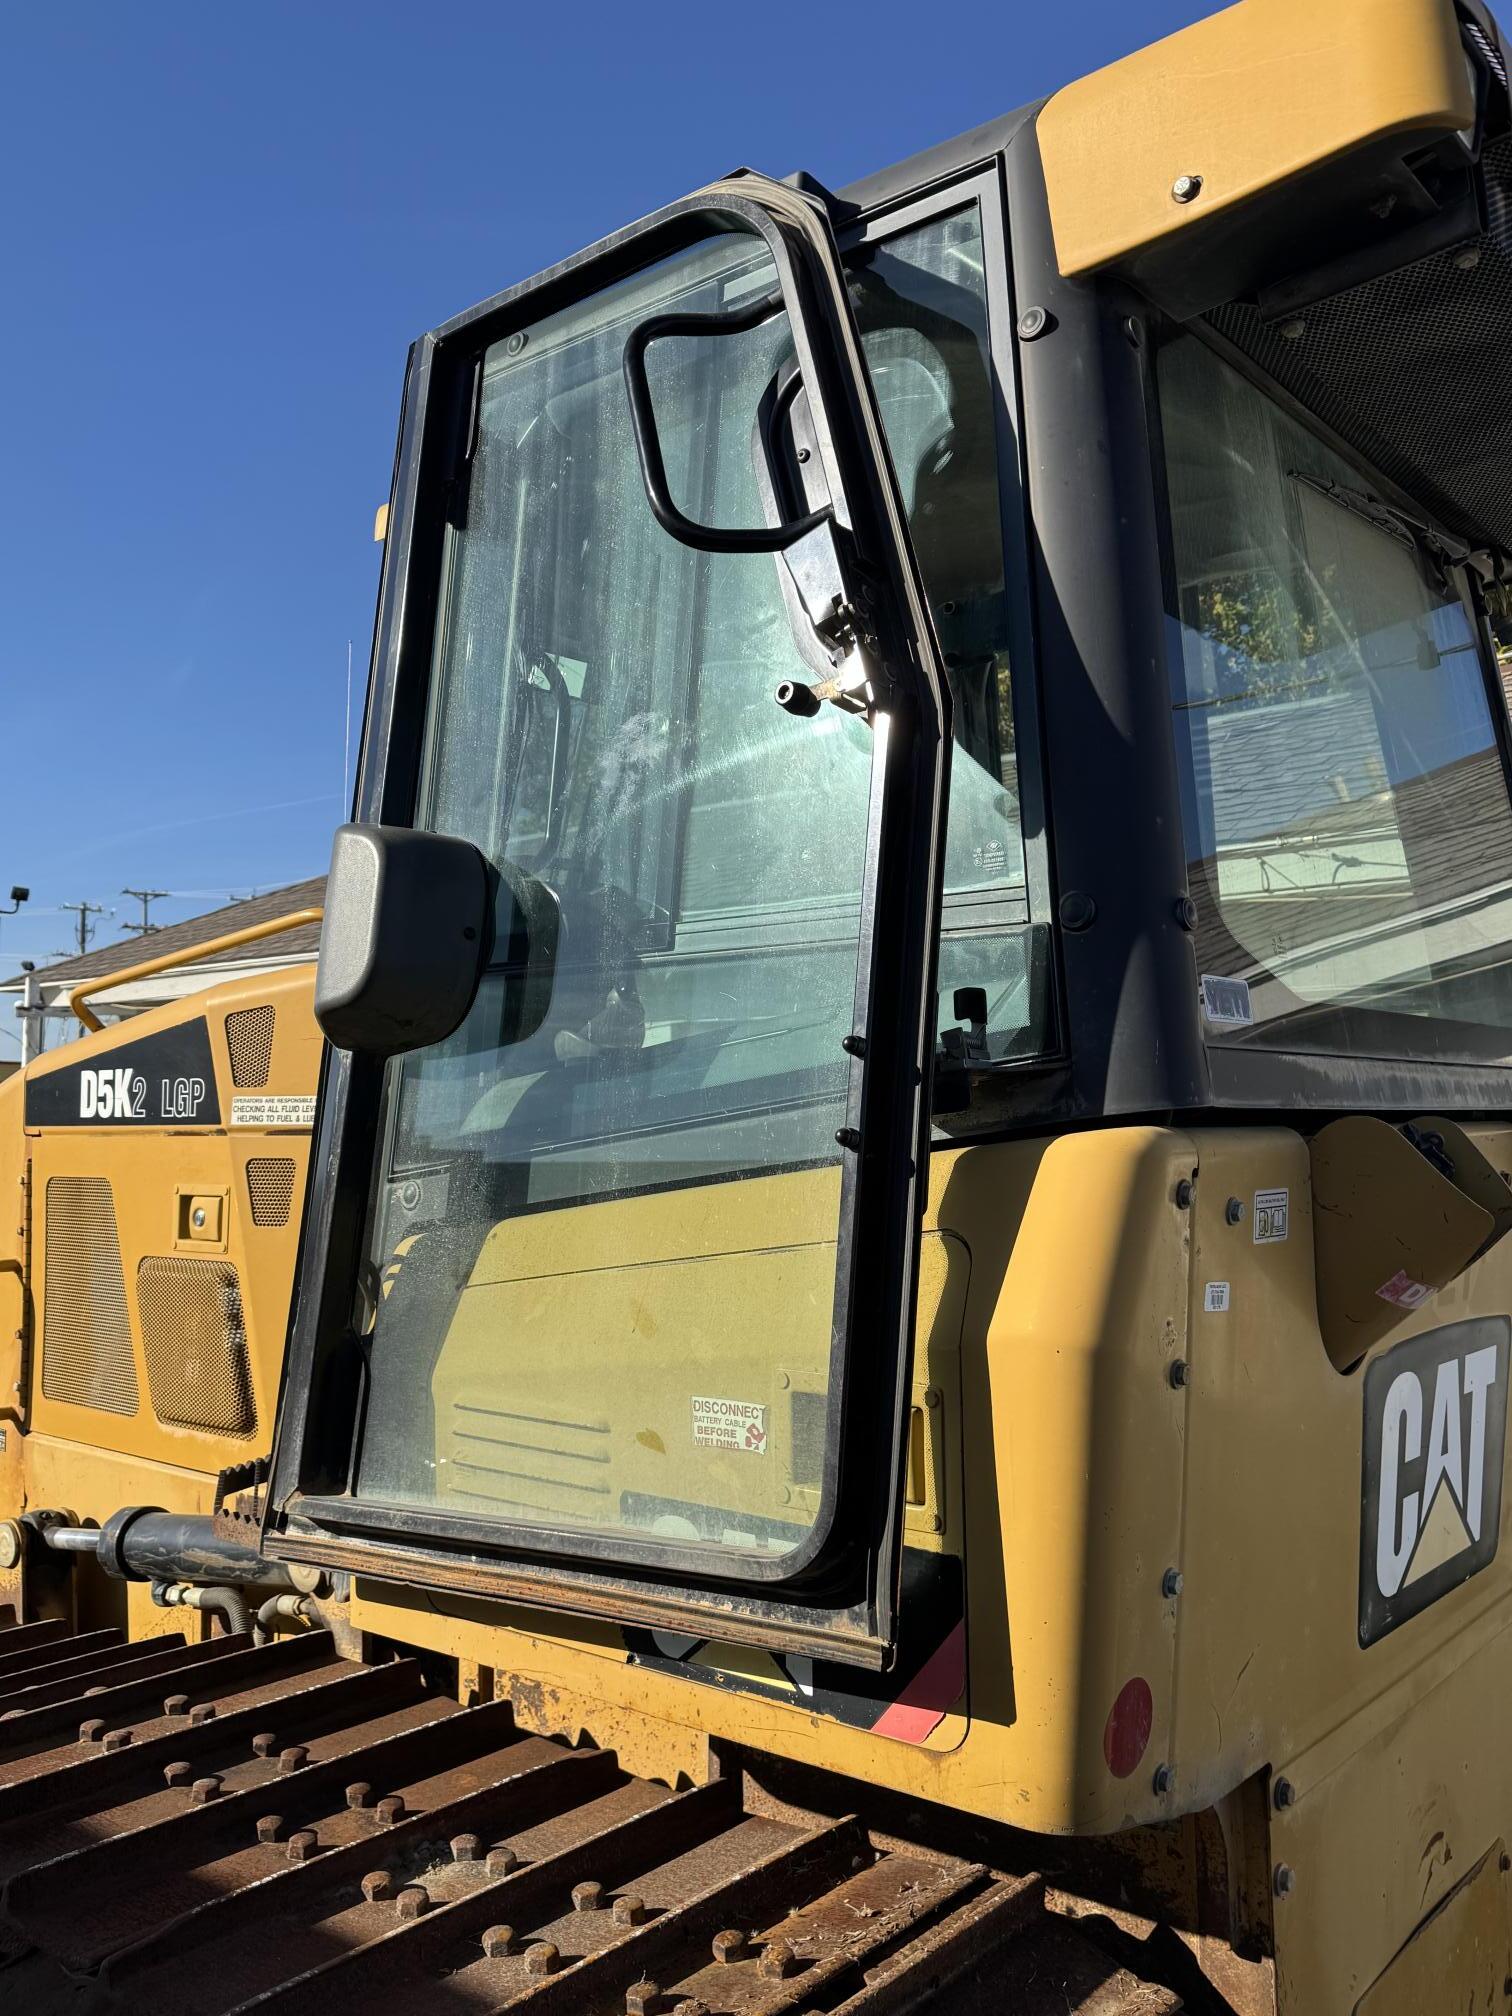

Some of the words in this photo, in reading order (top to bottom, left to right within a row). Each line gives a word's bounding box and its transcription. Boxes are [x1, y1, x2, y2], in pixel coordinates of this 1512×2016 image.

[80, 1068, 147, 1118] D5K2
[161, 1078, 205, 1118] LGP
[233, 1105, 265, 1113] CHECKING
[267, 1105, 280, 1113] ALL
[281, 1105, 300, 1113] FLUID
[237, 1114, 264, 1123] HELPING
[266, 1114, 275, 1123] TO
[276, 1114, 293, 1123] FUEL
[693, 1415, 722, 1425] BATTERY
[724, 1418, 747, 1429] CABLE
[697, 1425, 737, 1439] BEFORE
[1376, 1344, 1498, 1598] CAT
